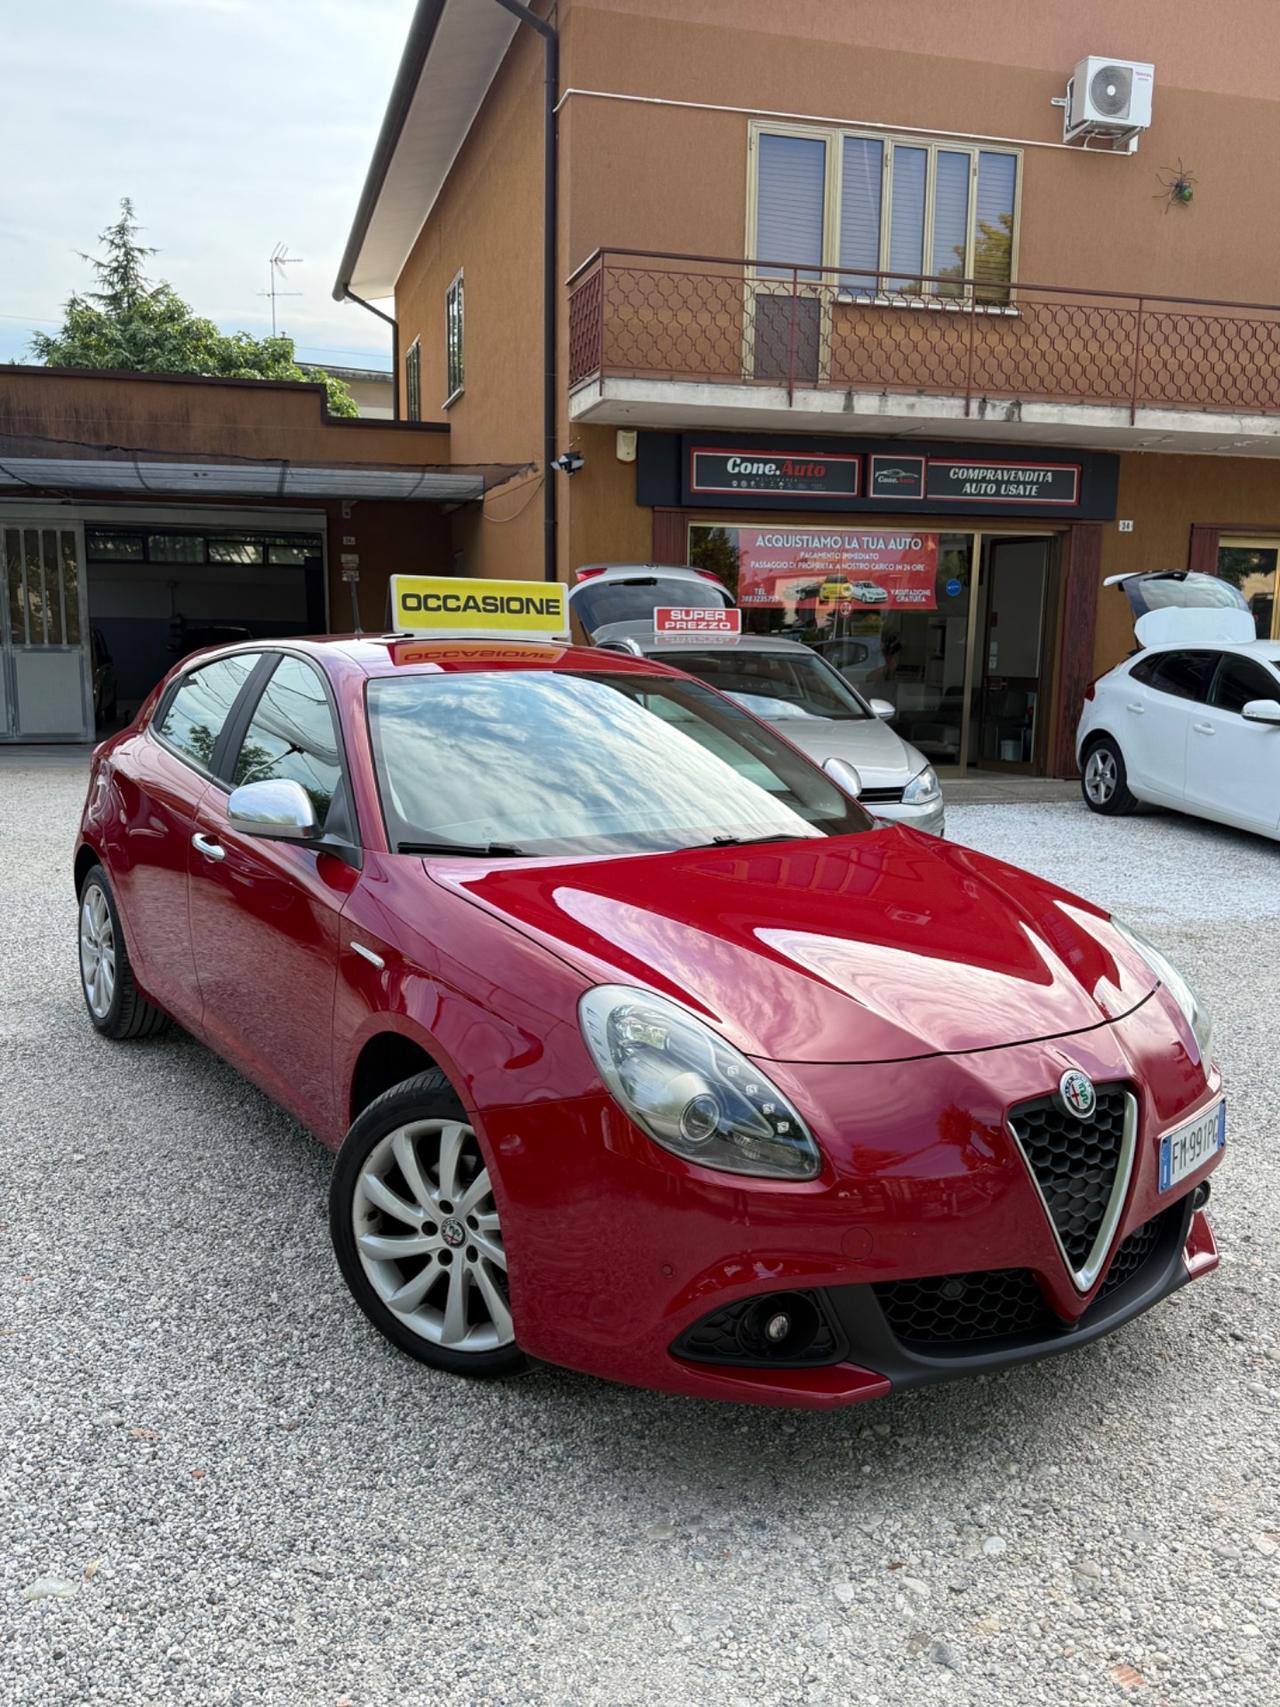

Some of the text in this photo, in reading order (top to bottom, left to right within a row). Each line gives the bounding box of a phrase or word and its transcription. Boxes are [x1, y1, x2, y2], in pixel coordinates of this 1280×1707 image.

[726, 456, 826, 477] Cone.Auto
[949, 467, 1053, 483] COMPRAVENDITA
[962, 482, 1040, 497] AUTO USATE
[755, 534, 923, 551] ACQUISTIAMO LA TUA AUTO
[402, 592, 561, 616] OCCASIONE
[670, 610, 726, 621] SUPER
[664, 621, 731, 630] PREZZO
